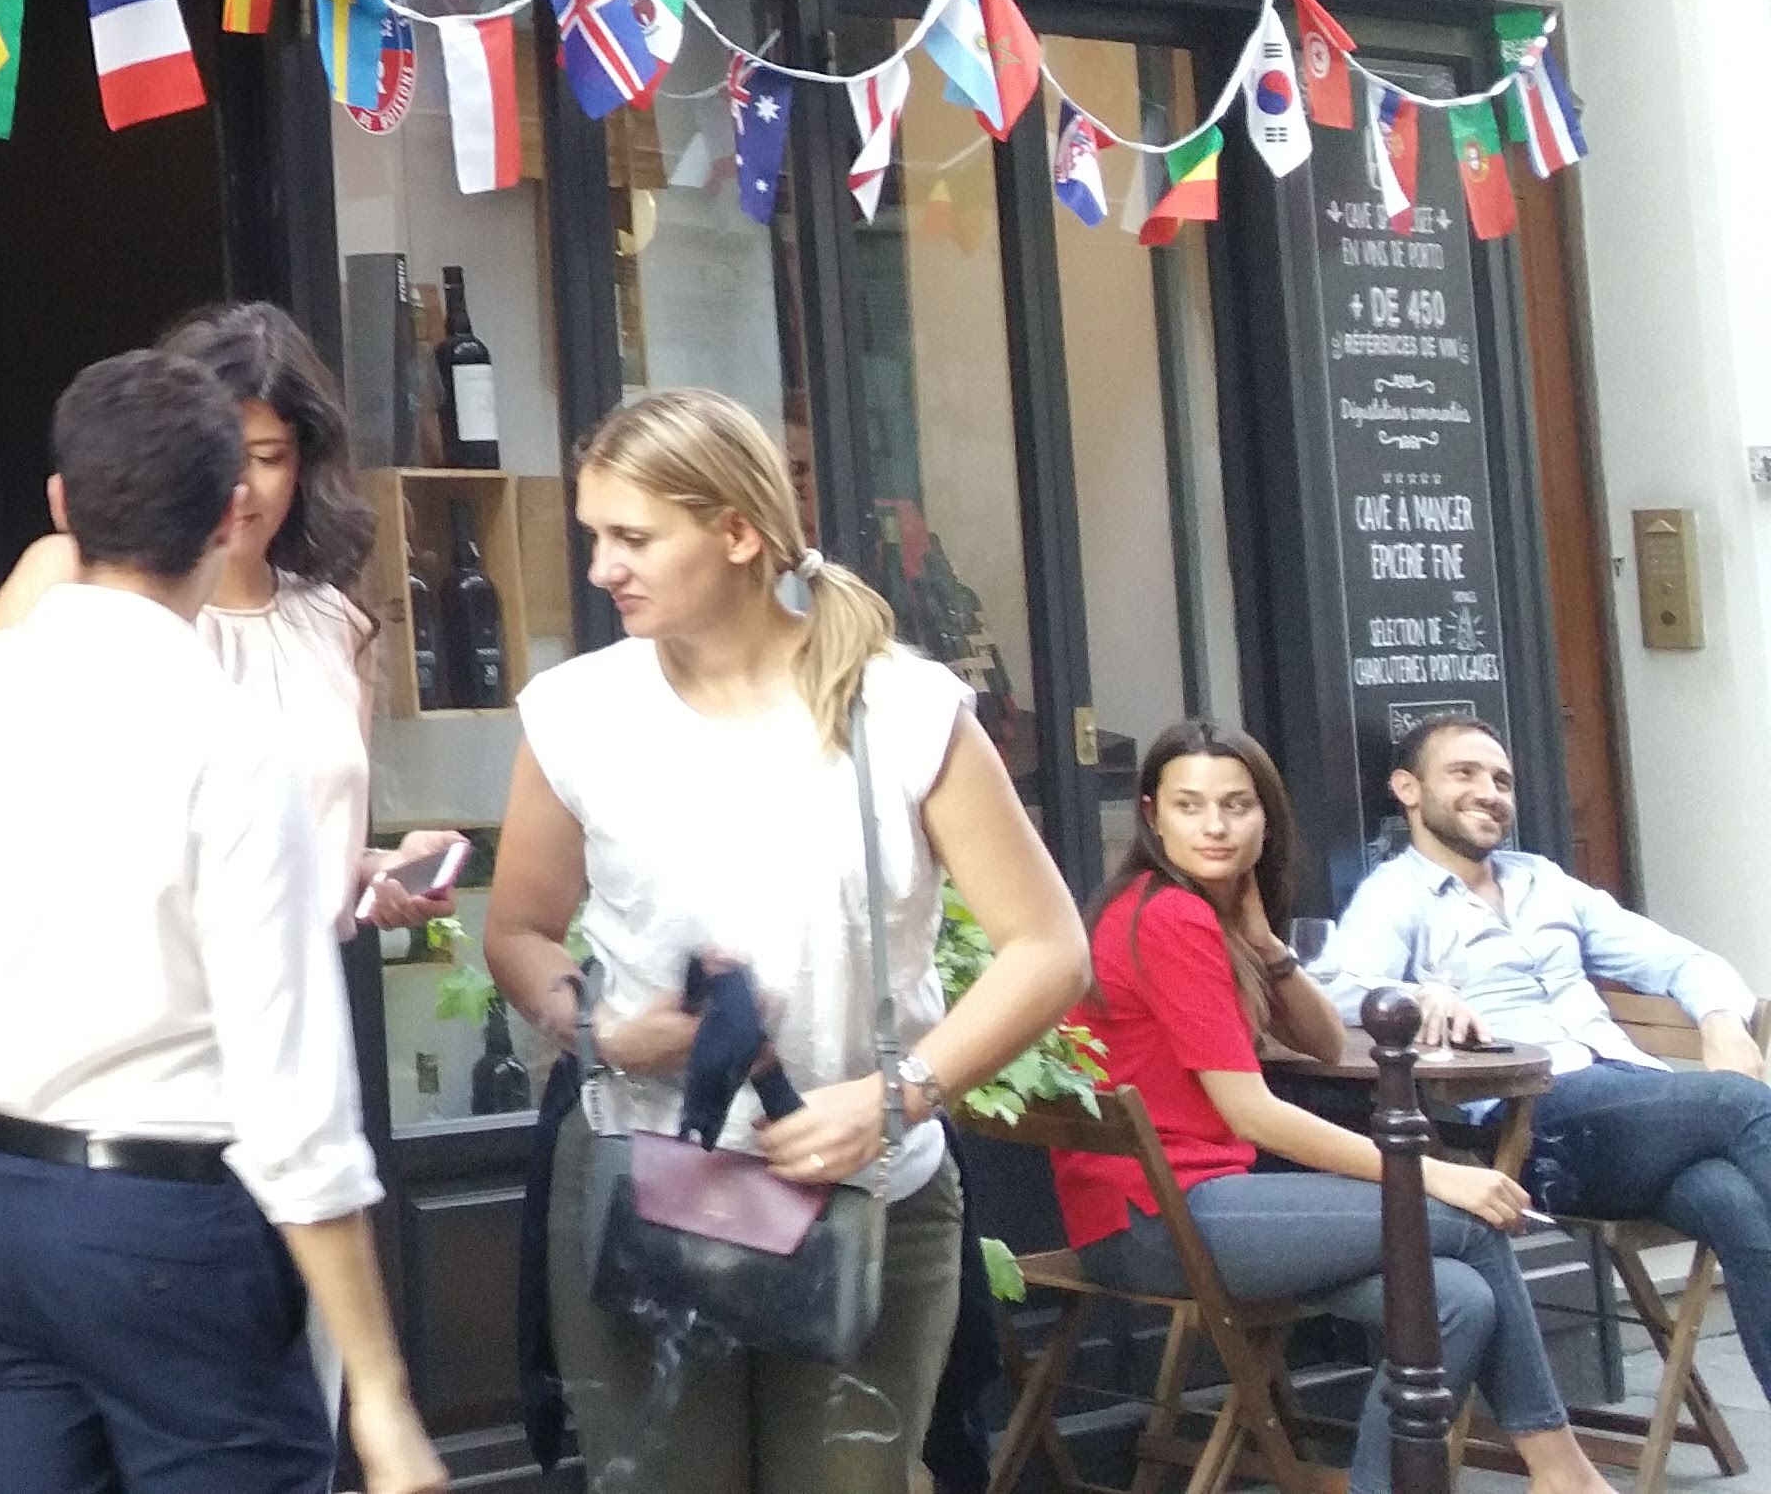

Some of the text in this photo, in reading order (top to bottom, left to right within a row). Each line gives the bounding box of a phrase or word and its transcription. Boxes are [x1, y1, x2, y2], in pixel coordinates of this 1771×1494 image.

[1370, 286, 1402, 329] DE
[1407, 288, 1446, 329] 450
[1355, 490, 1475, 533] CAVE À MANGER
[1430, 542, 1466, 581] FINE
[1427, 616, 1444, 646] DE
